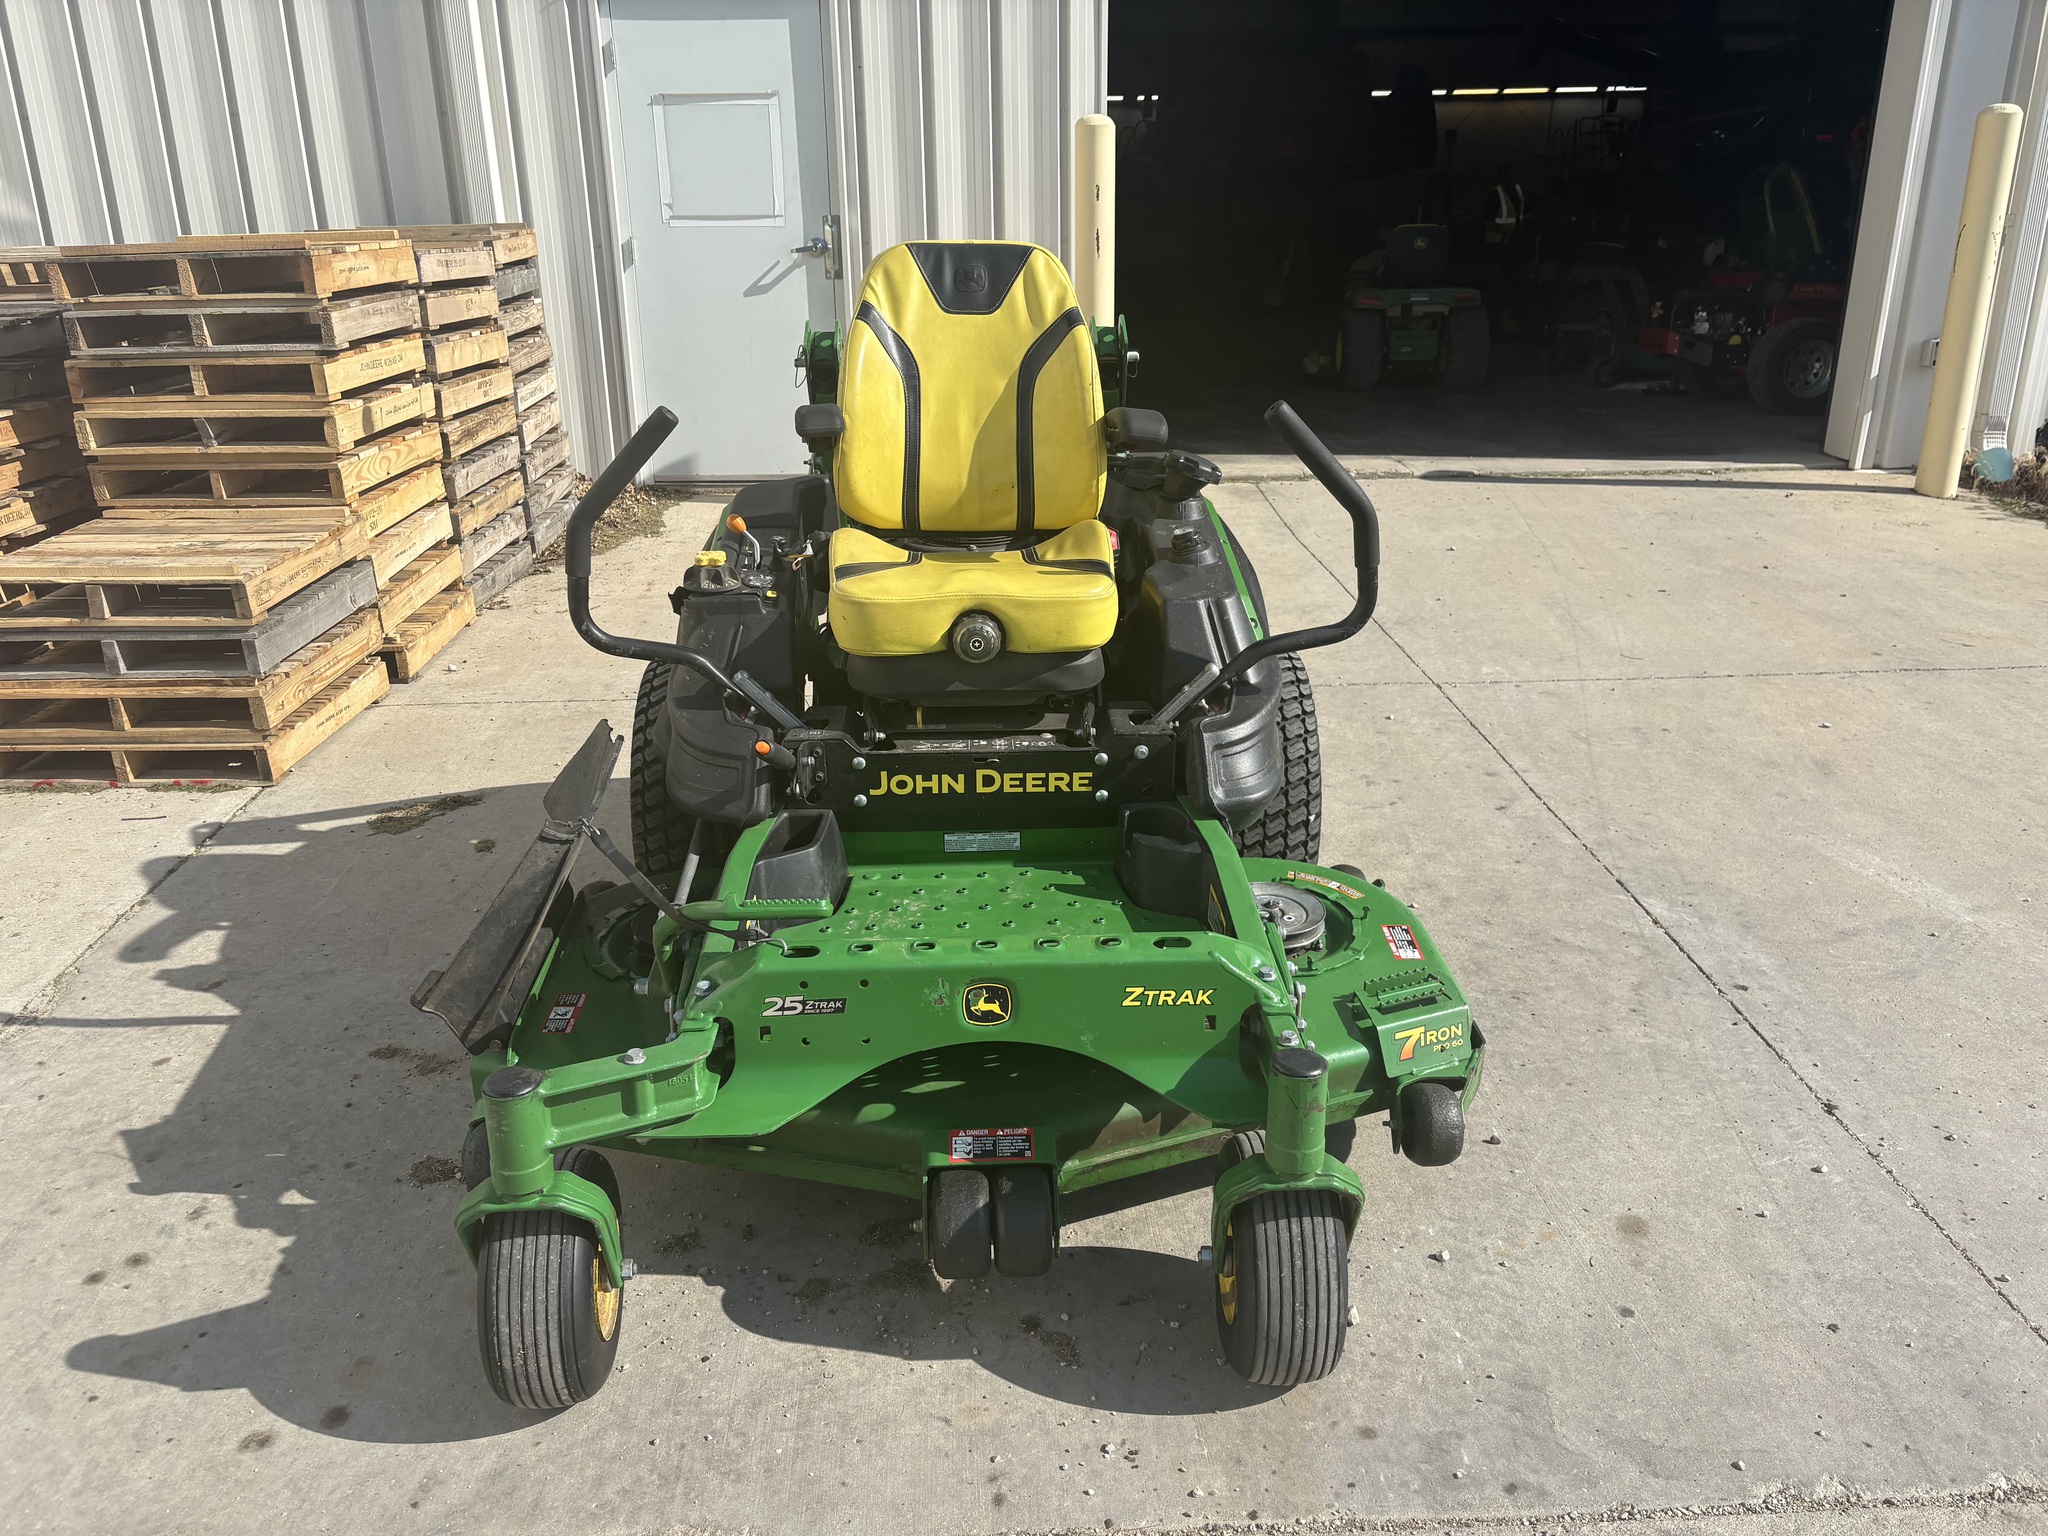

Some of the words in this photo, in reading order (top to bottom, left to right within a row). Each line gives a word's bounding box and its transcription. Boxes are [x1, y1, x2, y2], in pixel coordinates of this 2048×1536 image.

[869, 770, 965, 796] JOHN
[976, 768, 1093, 793] DEERE
[1121, 986, 1215, 1006] ZTRAK
[762, 995, 804, 1017] 25
[804, 1000, 843, 1010] ZTRAK
[1451, 1038, 1464, 1047] 60
[1003, 1127, 1028, 1135] PELIGRO
